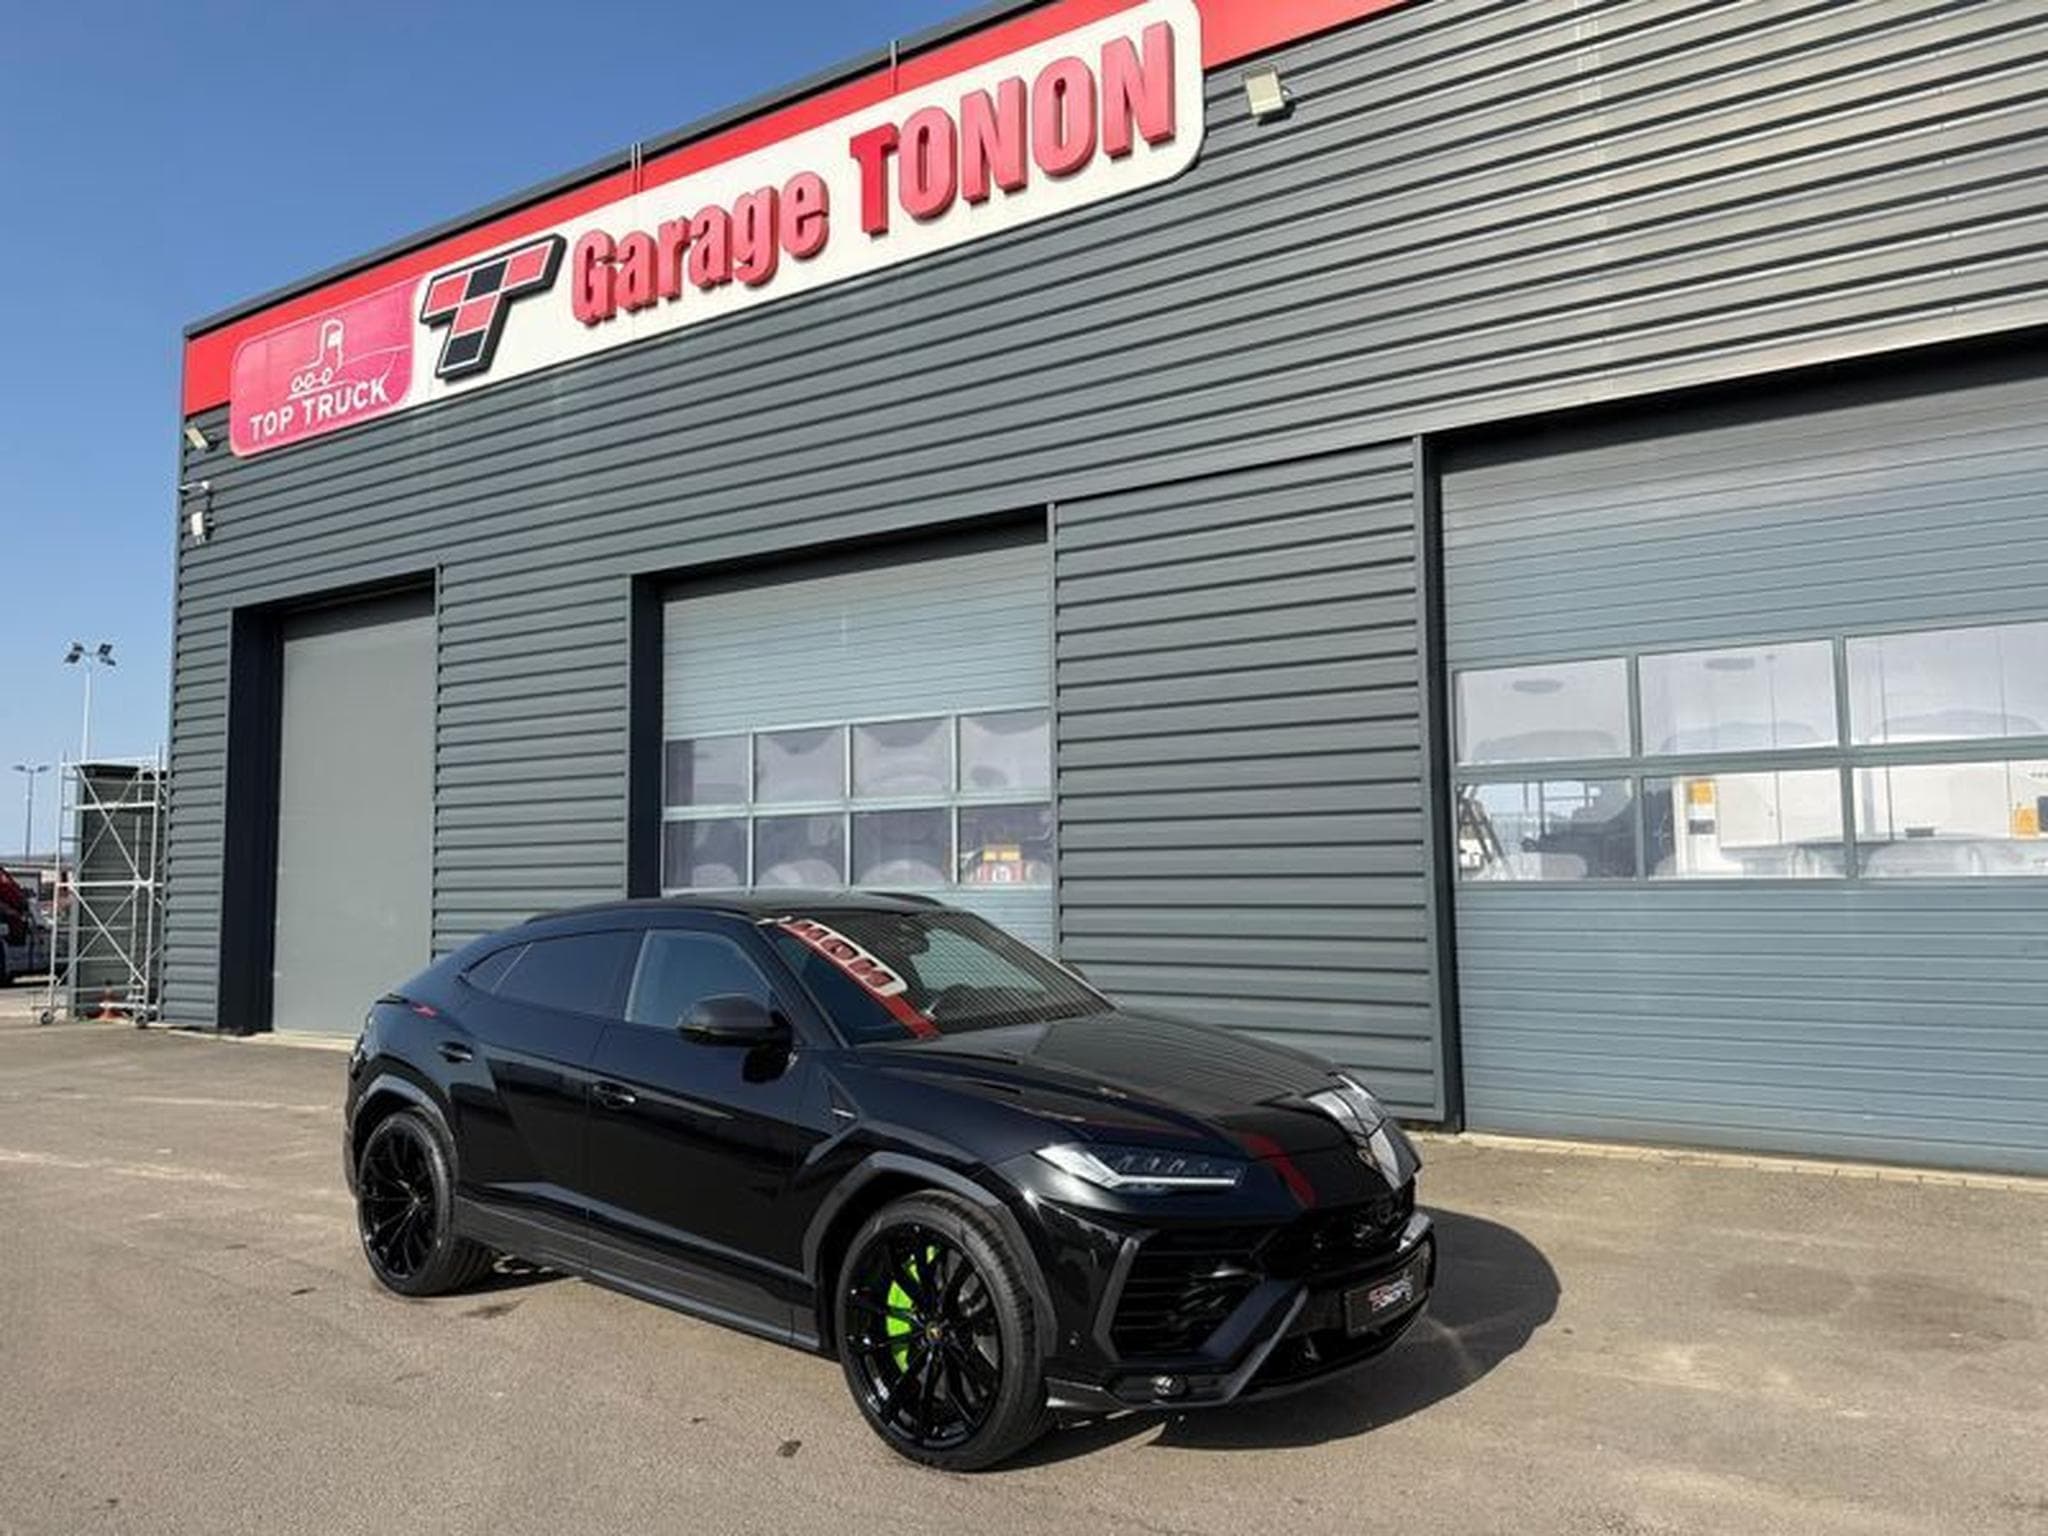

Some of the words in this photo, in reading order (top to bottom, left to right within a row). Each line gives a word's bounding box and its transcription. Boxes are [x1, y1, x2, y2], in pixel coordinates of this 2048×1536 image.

[571, 170, 830, 327] Garage
[849, 20, 1177, 238] TONON
[250, 405, 294, 441] TOP
[302, 377, 391, 426] TRUCK
